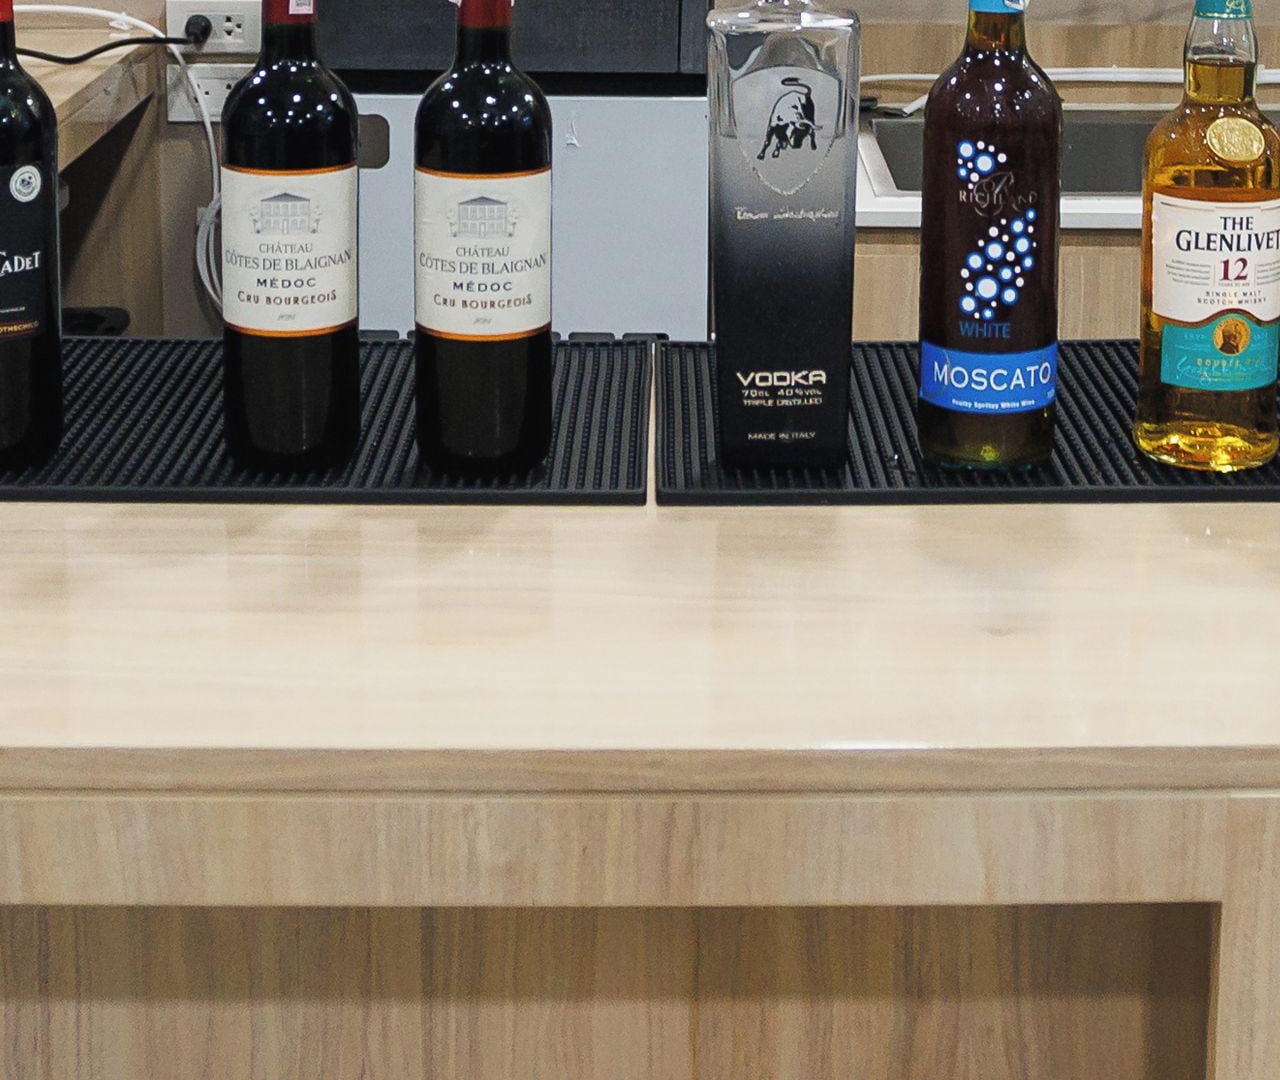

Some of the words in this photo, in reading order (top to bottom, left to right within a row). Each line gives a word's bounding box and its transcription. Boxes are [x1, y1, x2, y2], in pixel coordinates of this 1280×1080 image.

[1220, 216, 1254, 231] THE
[259, 242, 313, 254] CHÂTEAU
[455, 245, 510, 258] CHÂTEAU
[224, 249, 260, 270] CÔTES
[262, 258, 283, 271] DE
[285, 249, 352, 271] BLAIGNAN
[419, 253, 456, 273] CÔTES
[458, 261, 478, 275] DE
[481, 252, 547, 275] BLAIGNAN
[1220, 257, 1249, 281] 12
[256, 277, 317, 289] MÉDOC
[452, 280, 513, 293] MÉDOC
[237, 291, 260, 304] CRU
[265, 289, 337, 306] BOURGEOIS
[433, 294, 455, 308] CRU
[461, 293, 532, 309] BOURGEOIS
[959, 322, 1012, 338] WHITE
[736, 370, 827, 387] VODKA
[933, 361, 1052, 391] MOSCATO
[743, 399, 774, 407] TRIPLE
[747, 433, 776, 441] MADE
[778, 432, 790, 441] IN
[791, 431, 816, 439] ITALY
